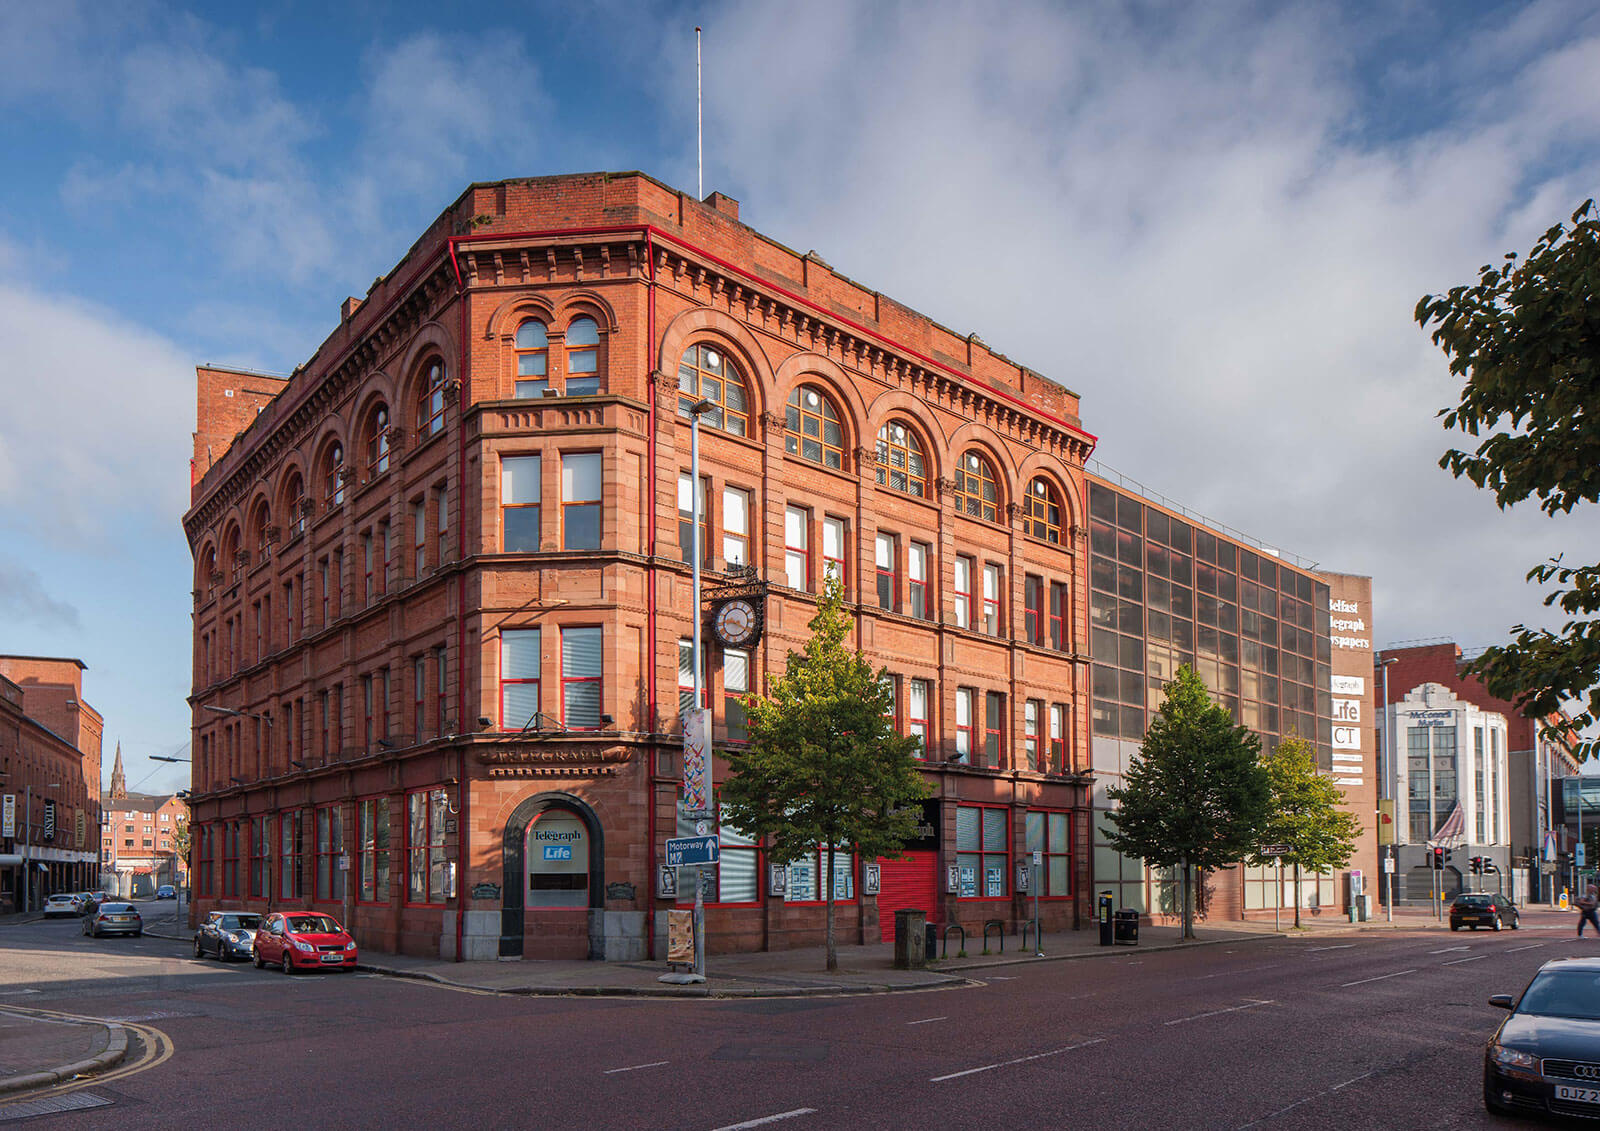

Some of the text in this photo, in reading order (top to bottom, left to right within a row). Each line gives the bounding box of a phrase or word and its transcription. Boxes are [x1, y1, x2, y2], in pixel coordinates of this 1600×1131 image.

[1330, 615, 1365, 633] legraph
[1334, 727, 1355, 744] CT
[45, 803, 54, 839] TITANIC
[535, 830, 581, 842] Telegraph
[545, 847, 570, 859] Life
[669, 841, 704, 851] Motorway
